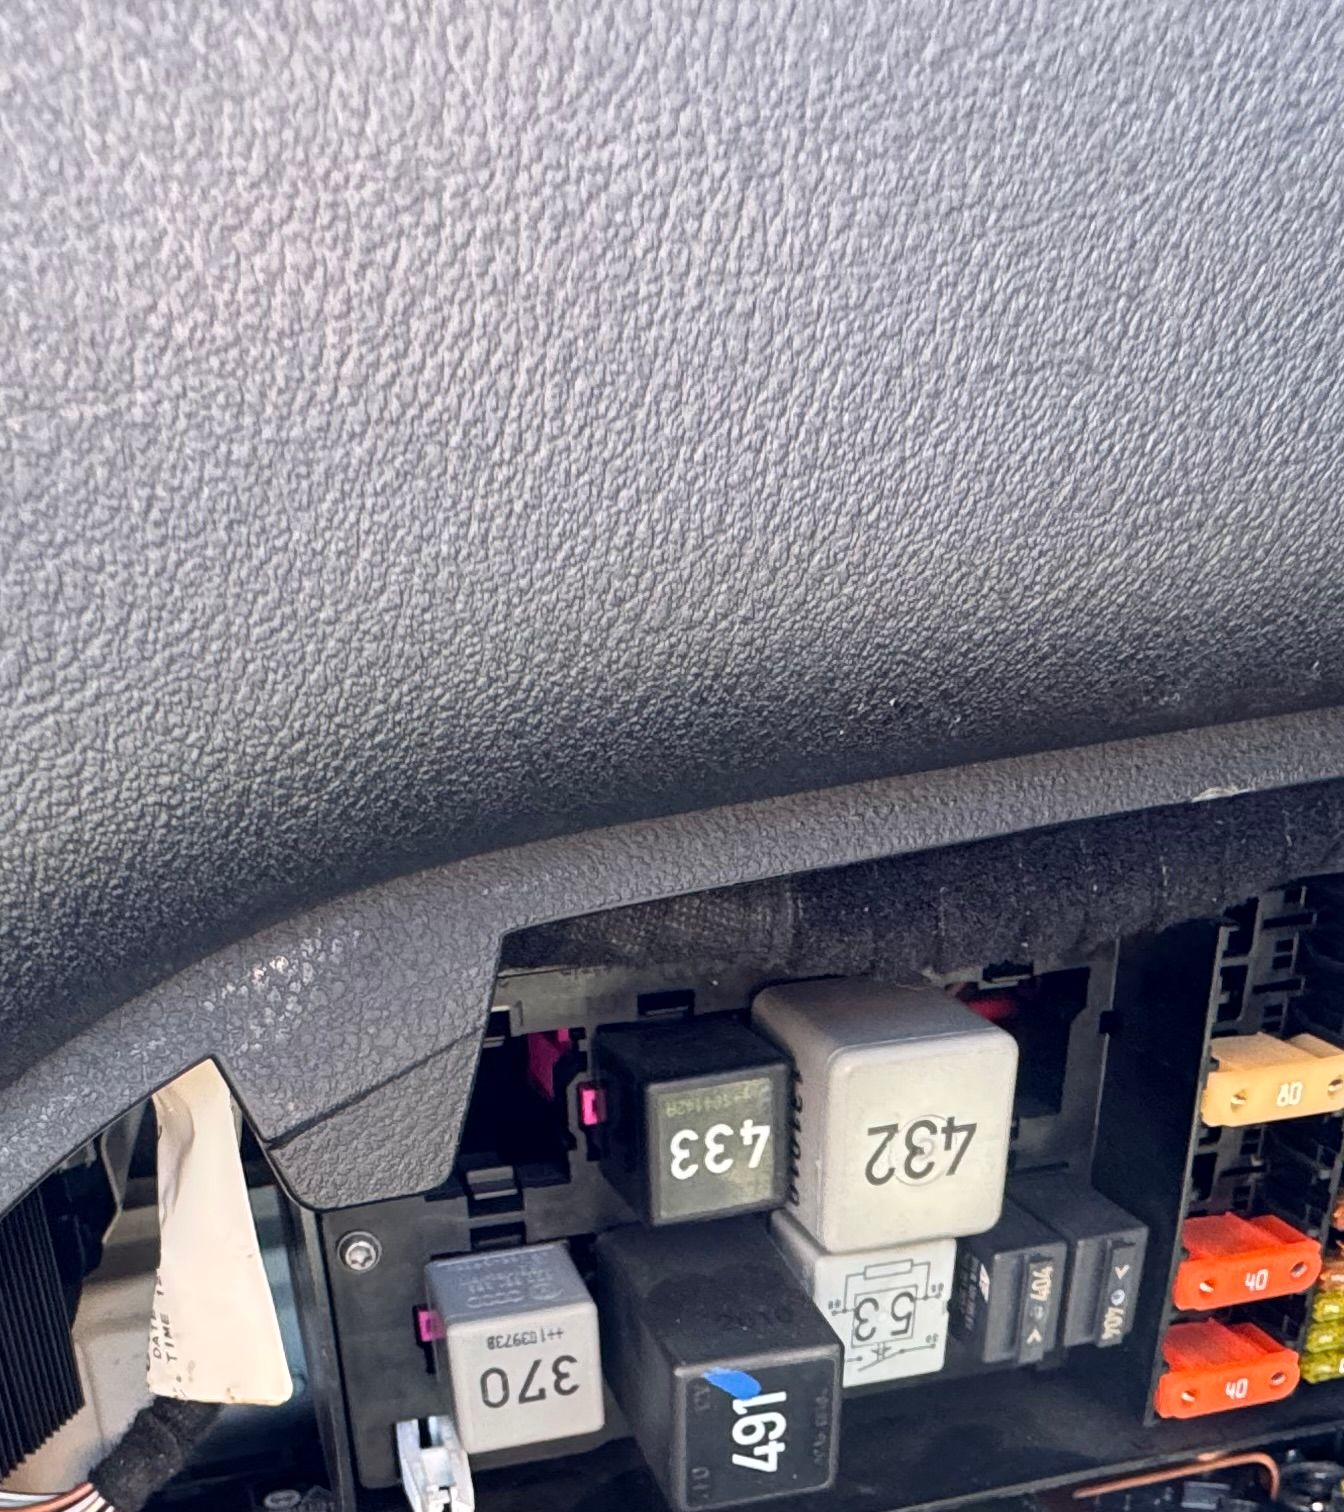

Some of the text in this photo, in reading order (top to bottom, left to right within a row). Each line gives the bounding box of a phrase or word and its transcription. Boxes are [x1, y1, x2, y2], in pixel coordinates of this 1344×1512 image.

[669, 1118, 772, 1181] 433
[864, 1115, 978, 1187] 432
[1244, 1268, 1270, 1292] 40
[853, 1291, 915, 1342] 53
[479, 1354, 581, 1409] 370
[1225, 1376, 1250, 1400] 40
[731, 1390, 788, 1473] 491
